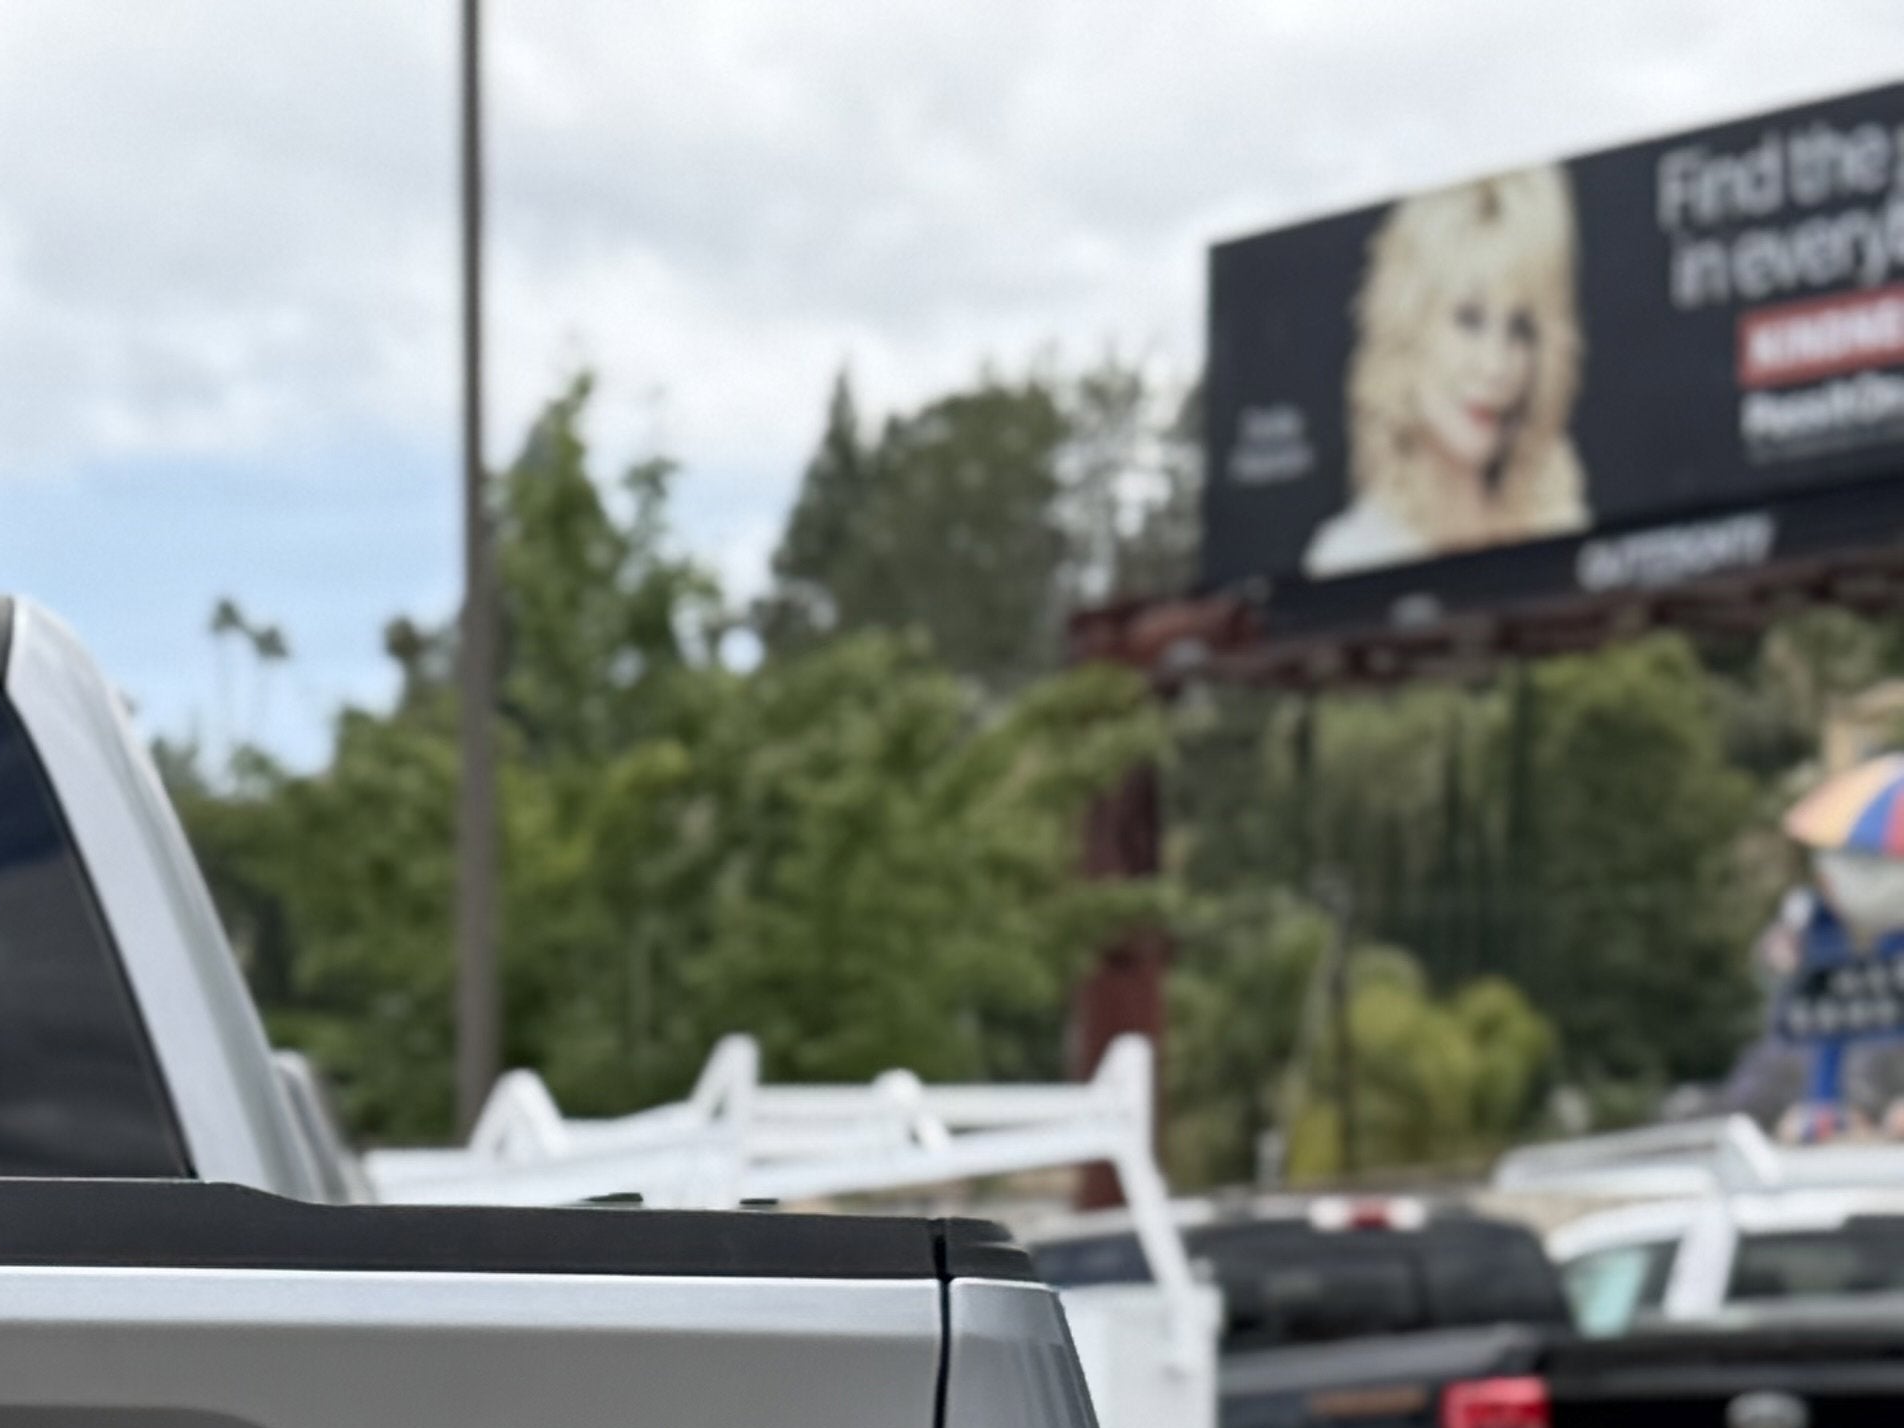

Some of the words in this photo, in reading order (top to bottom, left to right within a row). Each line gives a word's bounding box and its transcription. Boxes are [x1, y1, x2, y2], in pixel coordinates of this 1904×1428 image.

[1656, 130, 1783, 233] Find
[1789, 119, 1891, 206] the
[1669, 236, 1731, 309] in
